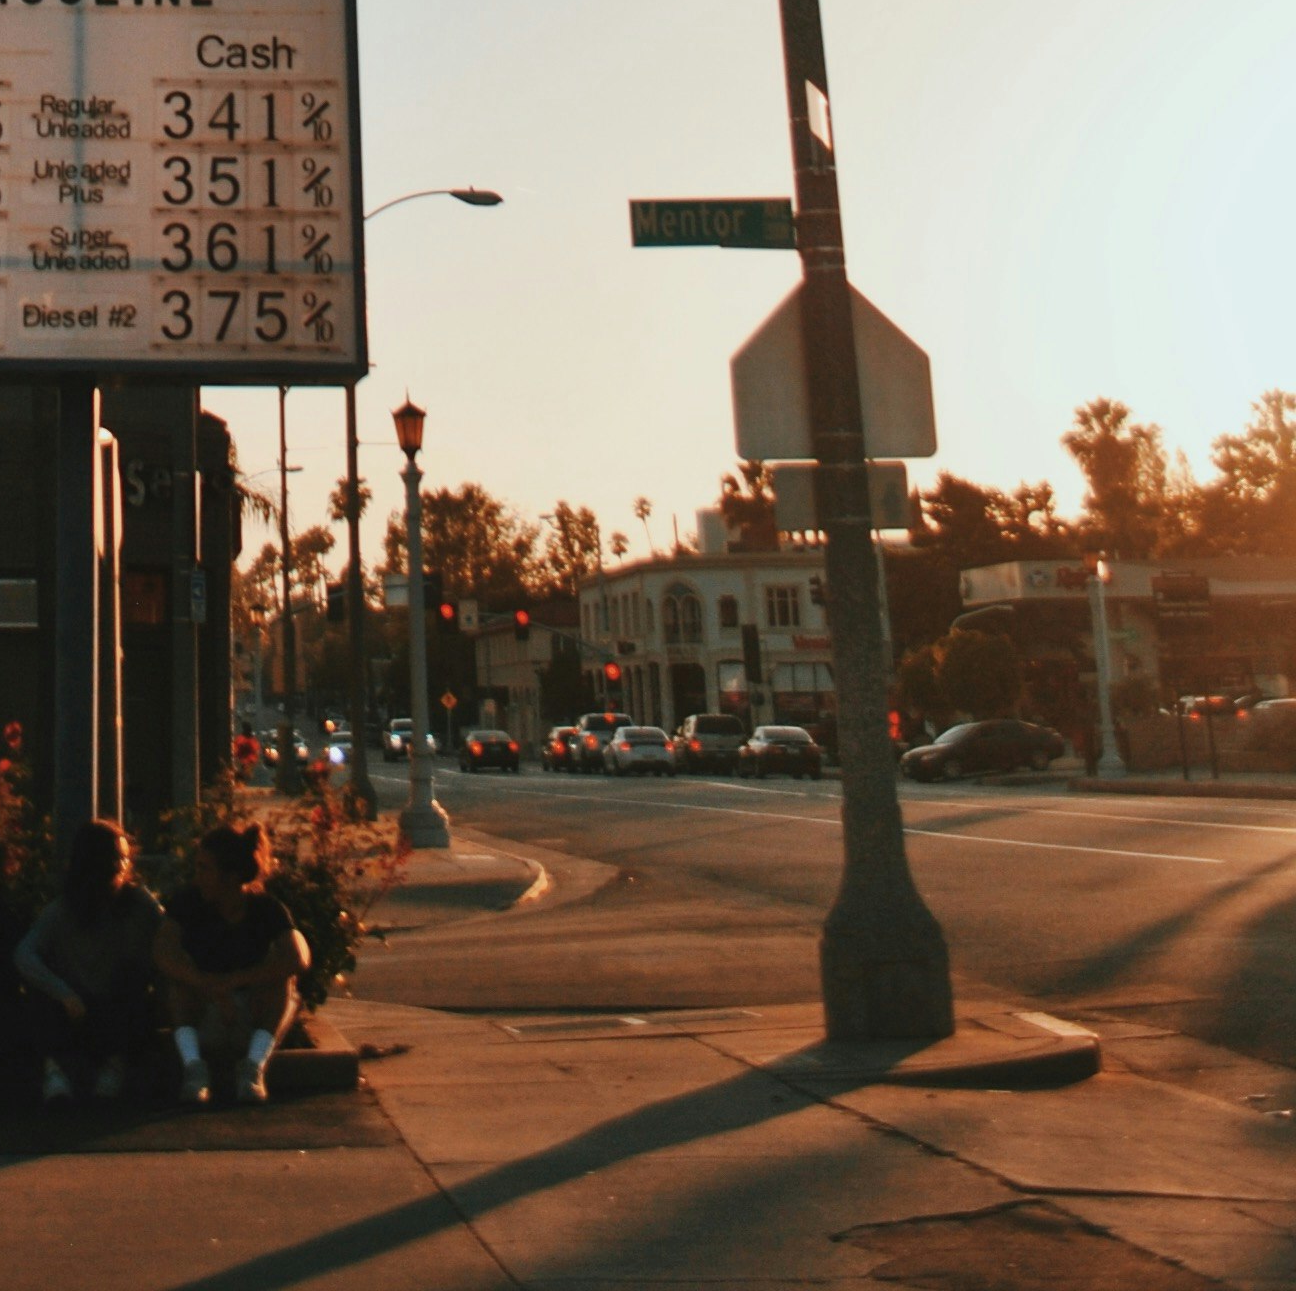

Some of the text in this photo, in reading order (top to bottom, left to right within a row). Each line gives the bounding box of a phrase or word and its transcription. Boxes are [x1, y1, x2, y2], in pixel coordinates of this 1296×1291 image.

[196, 34, 295, 69] Cash
[40, 94, 116, 119] Regular
[162, 90, 281, 142] 341
[35, 119, 132, 139] Unleaded
[33, 160, 132, 180] Unleaded
[161, 155, 281, 208] 351
[58, 184, 104, 204] Plus
[633, 202, 746, 238] Mentor
[50, 226, 114, 249] Super
[161, 222, 281, 275] 361
[32, 251, 131, 271] Unleaded
[22, 304, 137, 329] Diesel #2
[160, 289, 288, 343] 375
